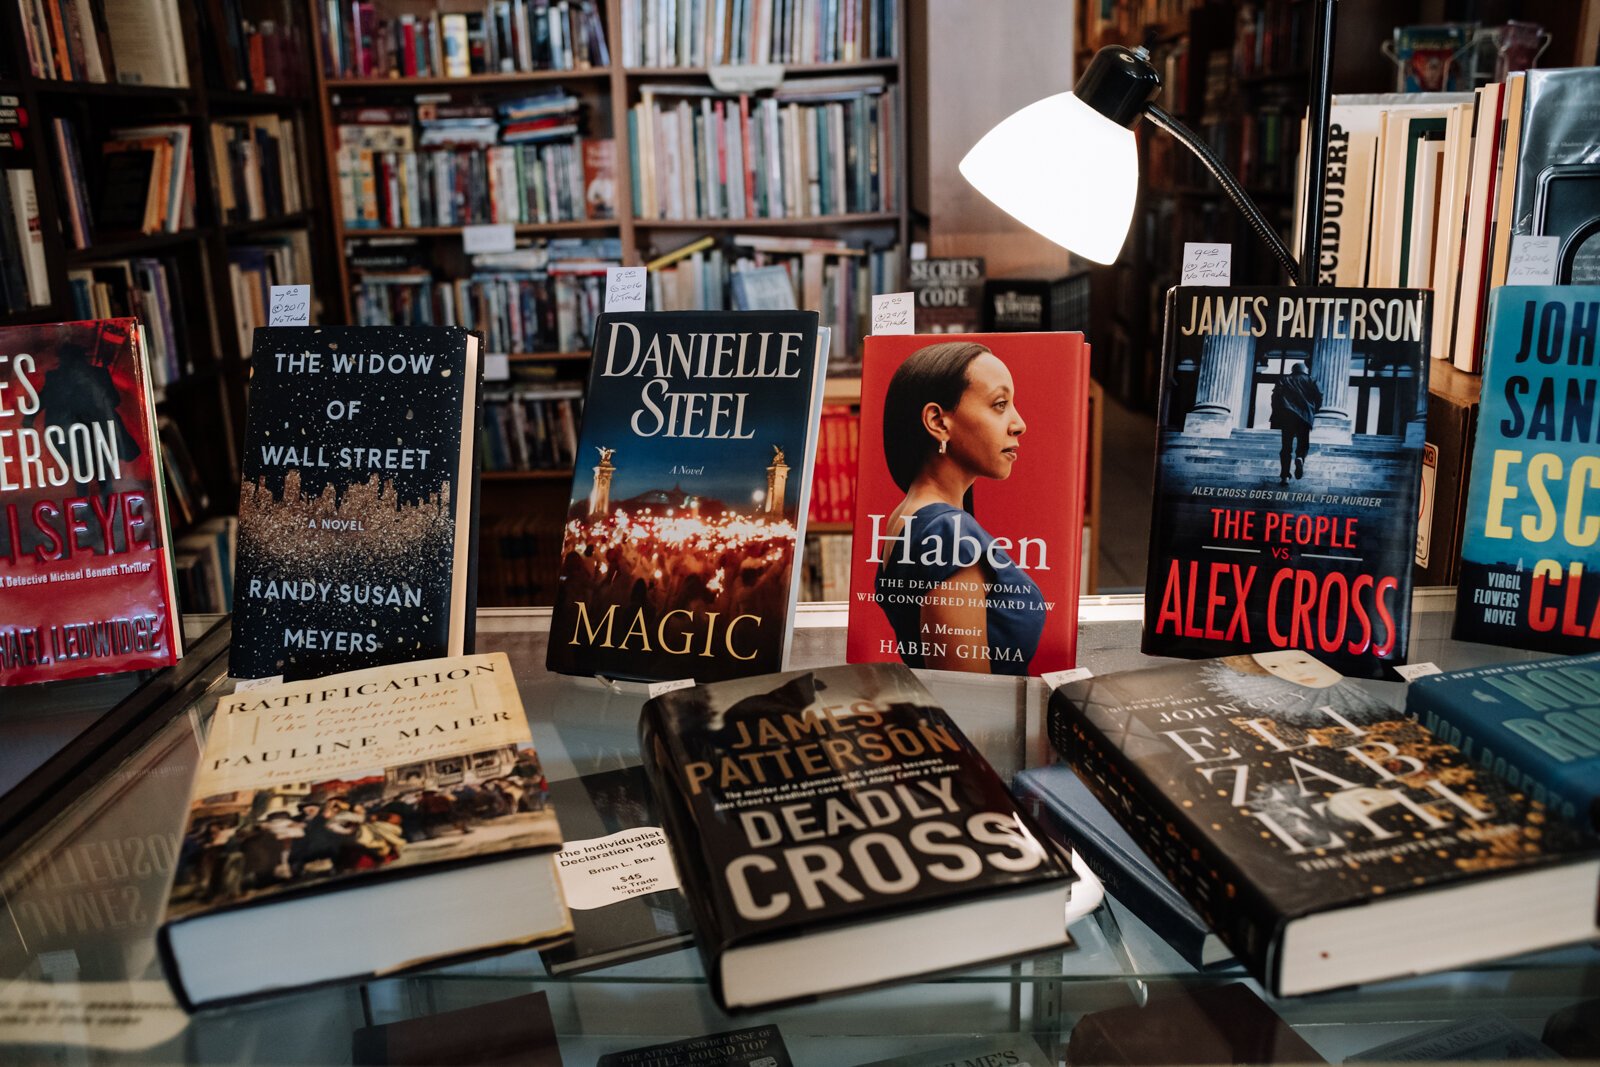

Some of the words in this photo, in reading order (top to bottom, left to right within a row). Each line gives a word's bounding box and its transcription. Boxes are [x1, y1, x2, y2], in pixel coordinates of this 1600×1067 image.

[909, 260, 980, 281] SECRETS
[1184, 272, 1198, 280] No
[1199, 269, 1229, 278] Trade
[919, 288, 968, 307] CODE
[271, 316, 284, 325] No
[284, 313, 307, 322] Trade
[883, 317, 908, 328] Trade
[1181, 296, 1269, 337] JAMES
[1276, 297, 1422, 342] PATTERSON
[601, 322, 803, 380] DANIELLE
[275, 353, 322, 374] THE
[332, 353, 435, 376] WIDOW
[326, 400, 362, 421] OF
[631, 379, 756, 440] STEEL
[1500, 374, 1600, 445] SAN
[0, 420, 122, 492] ERSON
[261, 445, 330, 468] WALL
[339, 448, 431, 471] STREET
[669, 465, 678, 475] A
[679, 465, 705, 477] Novel
[1192, 486, 1215, 497] ALEX
[1216, 487, 1247, 499] CROSS
[1249, 489, 1274, 501] GOES
[1275, 491, 1290, 501] ON
[1291, 492, 1318, 504] TRIAL
[1320, 493, 1339, 504] FOR
[1341, 495, 1383, 508] MURDER
[1484, 449, 1600, 547] ESC
[0, 490, 152, 568] LSEYE
[308, 518, 317, 530] A
[321, 518, 365, 532] NOVEL
[1211, 508, 1256, 541] THE
[1264, 511, 1359, 549] PEOPLE
[866, 514, 1051, 570] Haben
[6, 573, 48, 588] Detective
[50, 568, 84, 583] Michael
[86, 564, 119, 579] Bennett
[120, 561, 152, 575] Thriller
[1516, 557, 1524, 573] A
[250, 579, 332, 604] RANDY
[338, 584, 422, 608] SUSAN
[879, 578, 905, 589] THE
[909, 579, 979, 592] DEAFBLIND
[982, 582, 1032, 595] WOMAN
[1488, 571, 1522, 591] VIRGIL
[857, 592, 885, 603] WHO
[888, 594, 965, 608] CONQUERED
[968, 598, 1026, 610] HARVARD
[1029, 601, 1056, 612] LAW
[1155, 559, 1258, 644] ALEX
[1267, 567, 1398, 658] CROSS
[1474, 588, 1520, 608] FLOWERS
[921, 623, 930, 634] A
[934, 624, 983, 637] Memoir
[1484, 607, 1517, 627] NOVEL
[51, 614, 162, 663] LEDWIDGE
[284, 628, 378, 654] MEYERS
[879, 639, 947, 657] HABEN
[956, 644, 1024, 662] GIRMA
[1452, 671, 1475, 680] NEW
[1478, 667, 1504, 676] YORK
[1507, 663, 1539, 672] TIMES
[229, 662, 496, 715] RATIFICATION
[272, 712, 306, 723] The
[316, 701, 383, 717] People
[393, 689, 459, 704] Debate
[1159, 702, 1242, 723] JOHN
[1246, 691, 1308, 711] GUY
[276, 723, 308, 733] the
[731, 700, 886, 749] JAMES
[213, 734, 378, 770] PAULINE
[398, 711, 513, 741] MAIER
[374, 738, 470, 761] Scripture
[683, 724, 961, 795] PATTERSON
[714, 801, 735, 811] Alex
[773, 789, 816, 803] deadliest
[817, 784, 839, 794] case
[841, 779, 867, 790] since
[868, 773, 894, 786] Along
[896, 769, 922, 780] Came
[725, 789, 743, 799] The
[743, 785, 778, 797] murder
[780, 784, 791, 792] of
[799, 774, 847, 790] glamorous
[863, 764, 901, 778] socialite
[902, 758, 943, 769] becomes
[738, 776, 960, 849] DEADLY
[556, 849, 580, 859] The
[583, 831, 661, 854] Individualist
[560, 846, 634, 867] Declaration
[636, 838, 666, 850] 1968
[589, 864, 619, 875] Brian
[634, 856, 657, 865] Bex
[619, 872, 643, 883] $45
[725, 810, 1047, 922] CROSS
[612, 883, 628, 892] No
[628, 877, 659, 888] Trade
[688, 1041, 708, 1052] AND
[709, 1033, 753, 1047] DEFENSE
[759, 1029, 772, 1038] OF
[688, 1044, 736, 1061] ROUND
[741, 1039, 768, 1051] TOP
